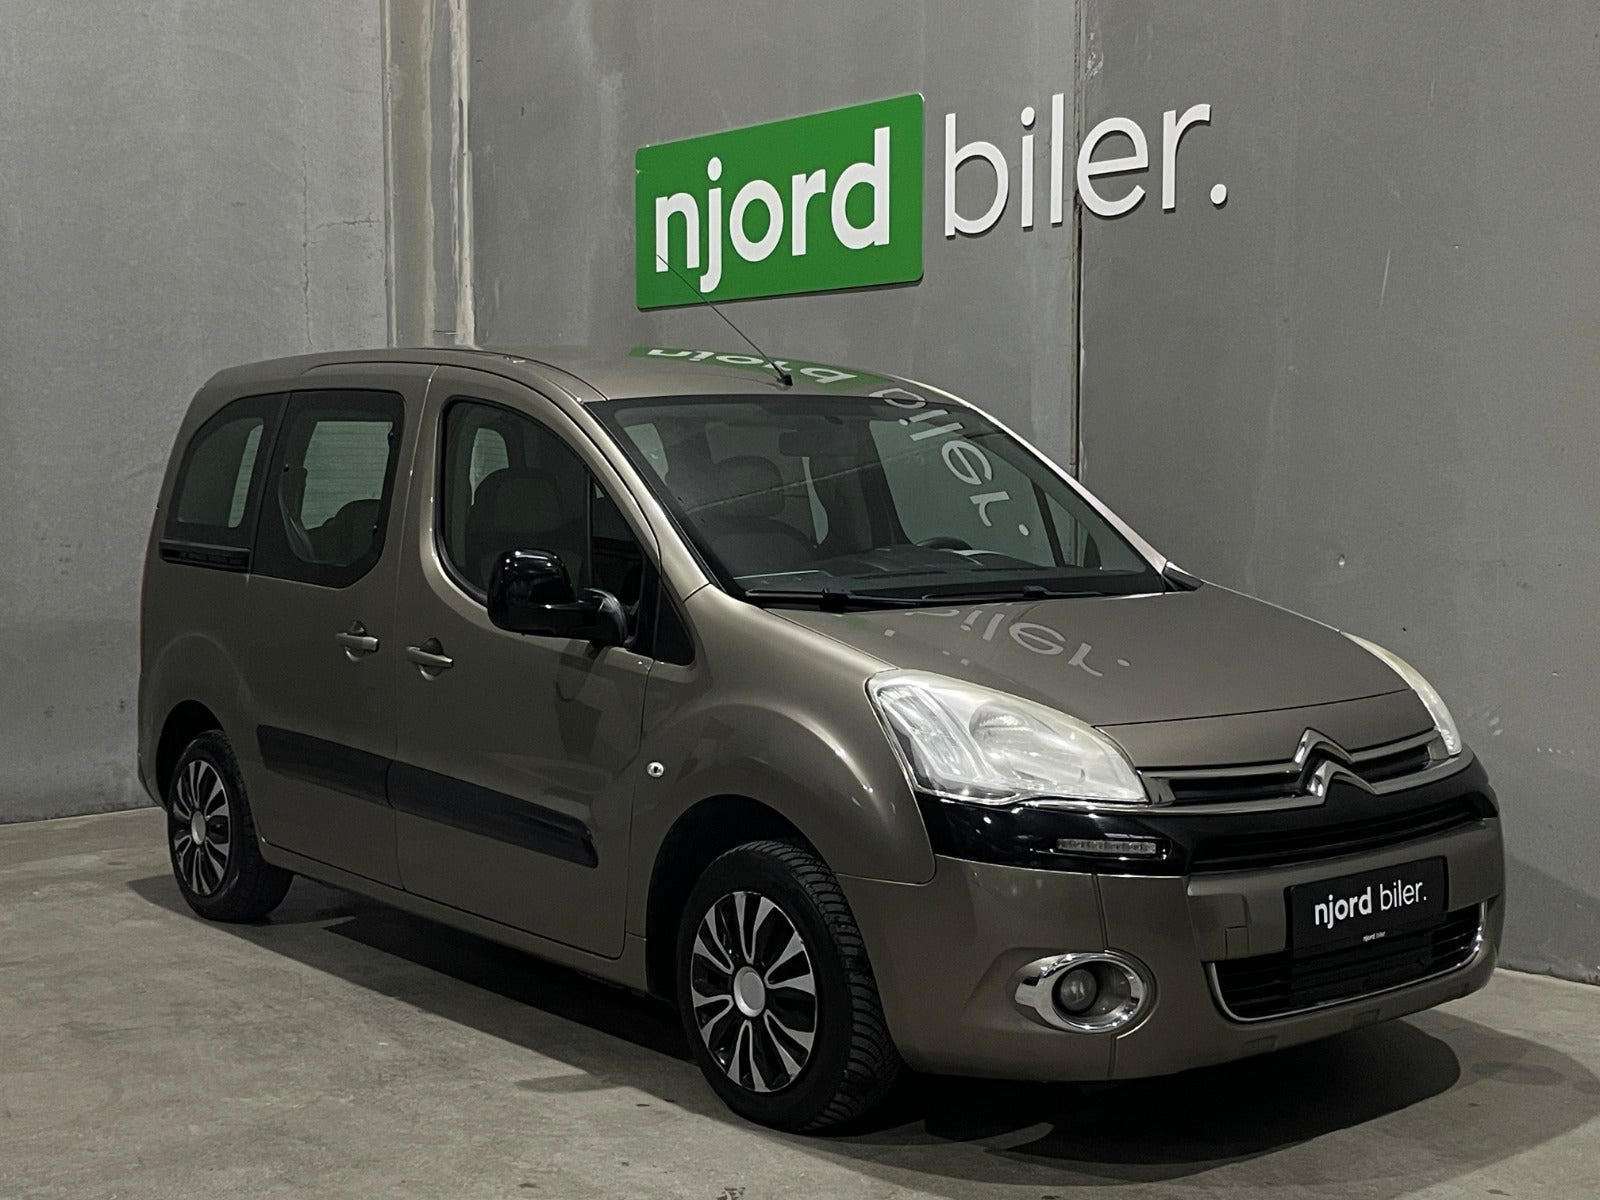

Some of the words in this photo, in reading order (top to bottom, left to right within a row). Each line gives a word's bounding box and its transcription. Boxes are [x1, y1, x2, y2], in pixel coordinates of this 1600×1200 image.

[655, 126, 891, 294] njord
[944, 93, 1229, 237] biler.
[1314, 886, 1373, 929] njord
[1379, 879, 1427, 912] biler.
